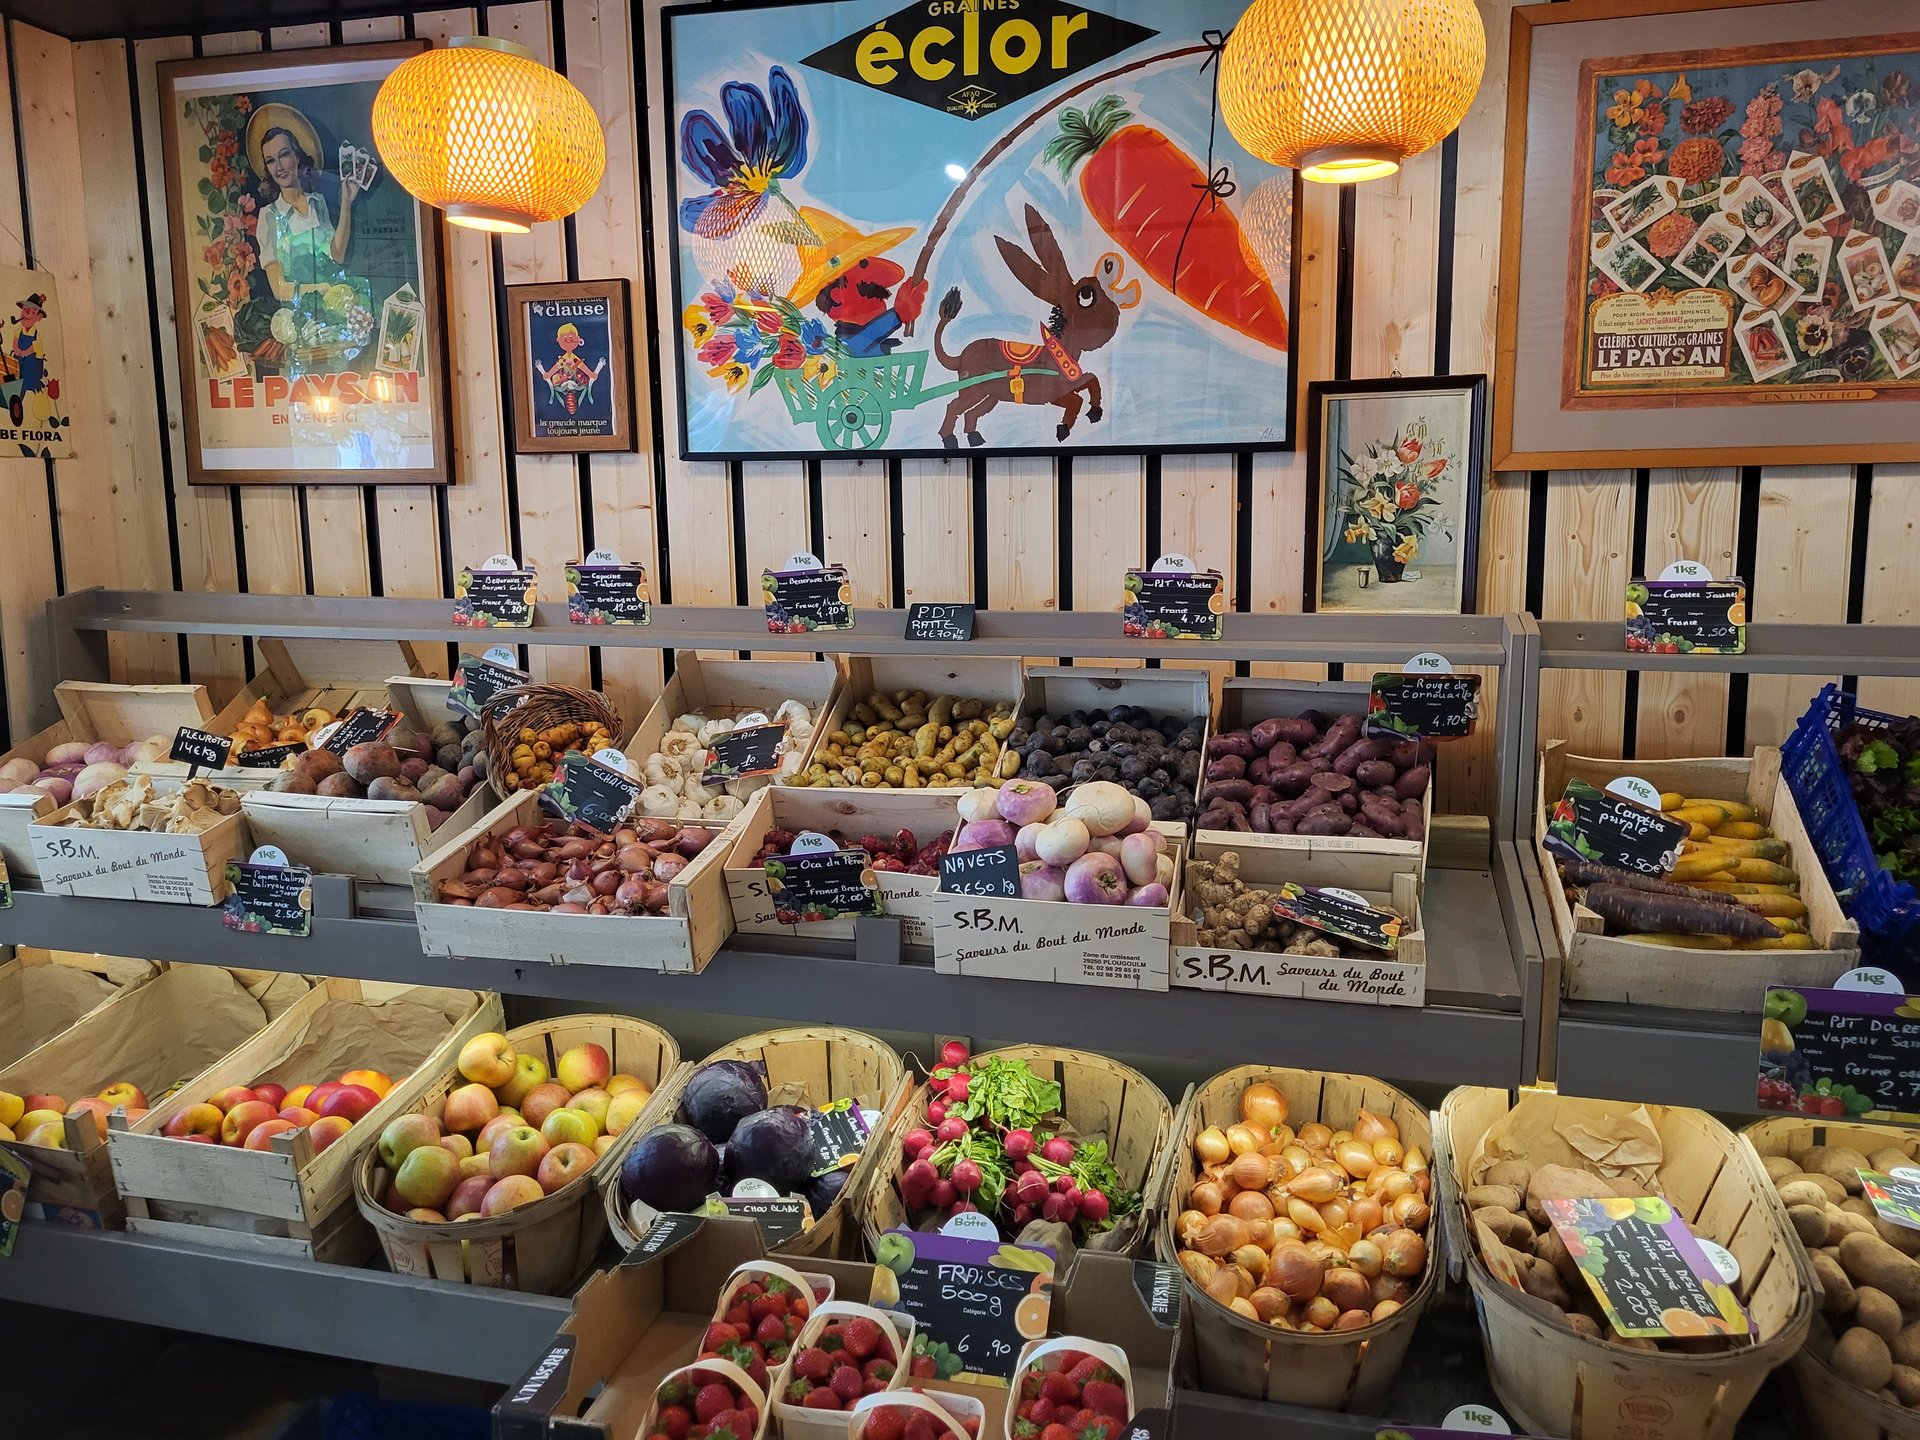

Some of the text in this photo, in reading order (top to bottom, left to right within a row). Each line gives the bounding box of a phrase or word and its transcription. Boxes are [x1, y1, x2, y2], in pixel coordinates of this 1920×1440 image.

[856, 0, 1088, 85] éclor
[546, 303, 604, 317] clause
[1635, 316, 1683, 326] SACHETS GRAINES
[1598, 331, 1724, 349] CÉLÈBRES CULTURES DE GRAINES
[1597, 346, 1722, 368] LE PAYSAN
[209, 372, 419, 409] LE PAYSAN
[1786, 392, 1836, 400] VENTE
[1841, 391, 1860, 399] ICI
[272, 411, 359, 425] EN VENTE ICI
[540, 418, 607, 429] la grande marque
[22, 430, 63, 442] FLORA
[547, 427, 601, 437] toujours jeune
[492, 557, 508, 566] 1kg
[595, 552, 612, 561] 1kg
[793, 556, 812, 566] 1kg
[1163, 557, 1185, 568] 1kg
[1673, 564, 1698, 576] 1kg
[591, 572, 622, 584] Capucine
[1663, 589, 1701, 599] Carottes
[795, 602, 820, 610] France
[1160, 606, 1189, 614] France
[911, 619, 958, 630] RATTE
[1667, 617, 1698, 627] France
[494, 649, 510, 661] 1kg
[1417, 657, 1440, 668] 1kg
[1415, 678, 1451, 694] Rouge
[605, 751, 622, 765] 1kg
[1626, 780, 1652, 799] 1kg
[1598, 812, 1649, 836] purple
[800, 837, 823, 847] 1kg
[46, 838, 100, 860] S.B.M.
[257, 850, 276, 860] 1kg
[55, 848, 187, 886] Saveurs du Bout du Monde
[800, 859, 823, 870] Oca
[944, 850, 1007, 874] NAVETS
[809, 888, 839, 896] France
[953, 908, 1024, 934] S.B.M.
[955, 921, 1147, 962] Saveurs du Bout du Monde
[1103, 959, 1147, 968] PLOUGOULM
[1182, 954, 1272, 986] S.B.M.
[1276, 962, 1405, 982] Saveurs du Bout
[1854, 972, 1886, 986] 1kg
[1319, 979, 1406, 997] du Monde
[1829, 1015, 1864, 1029] PdT
[743, 1204, 800, 1214] CHOU BLANC
[954, 1217, 988, 1227] Botte
[910, 1267, 929, 1276] Produit
[906, 1299, 924, 1308] Calibre
[941, 1284, 1002, 1317] 500g
[1462, 1409, 1494, 1426] 1kg
